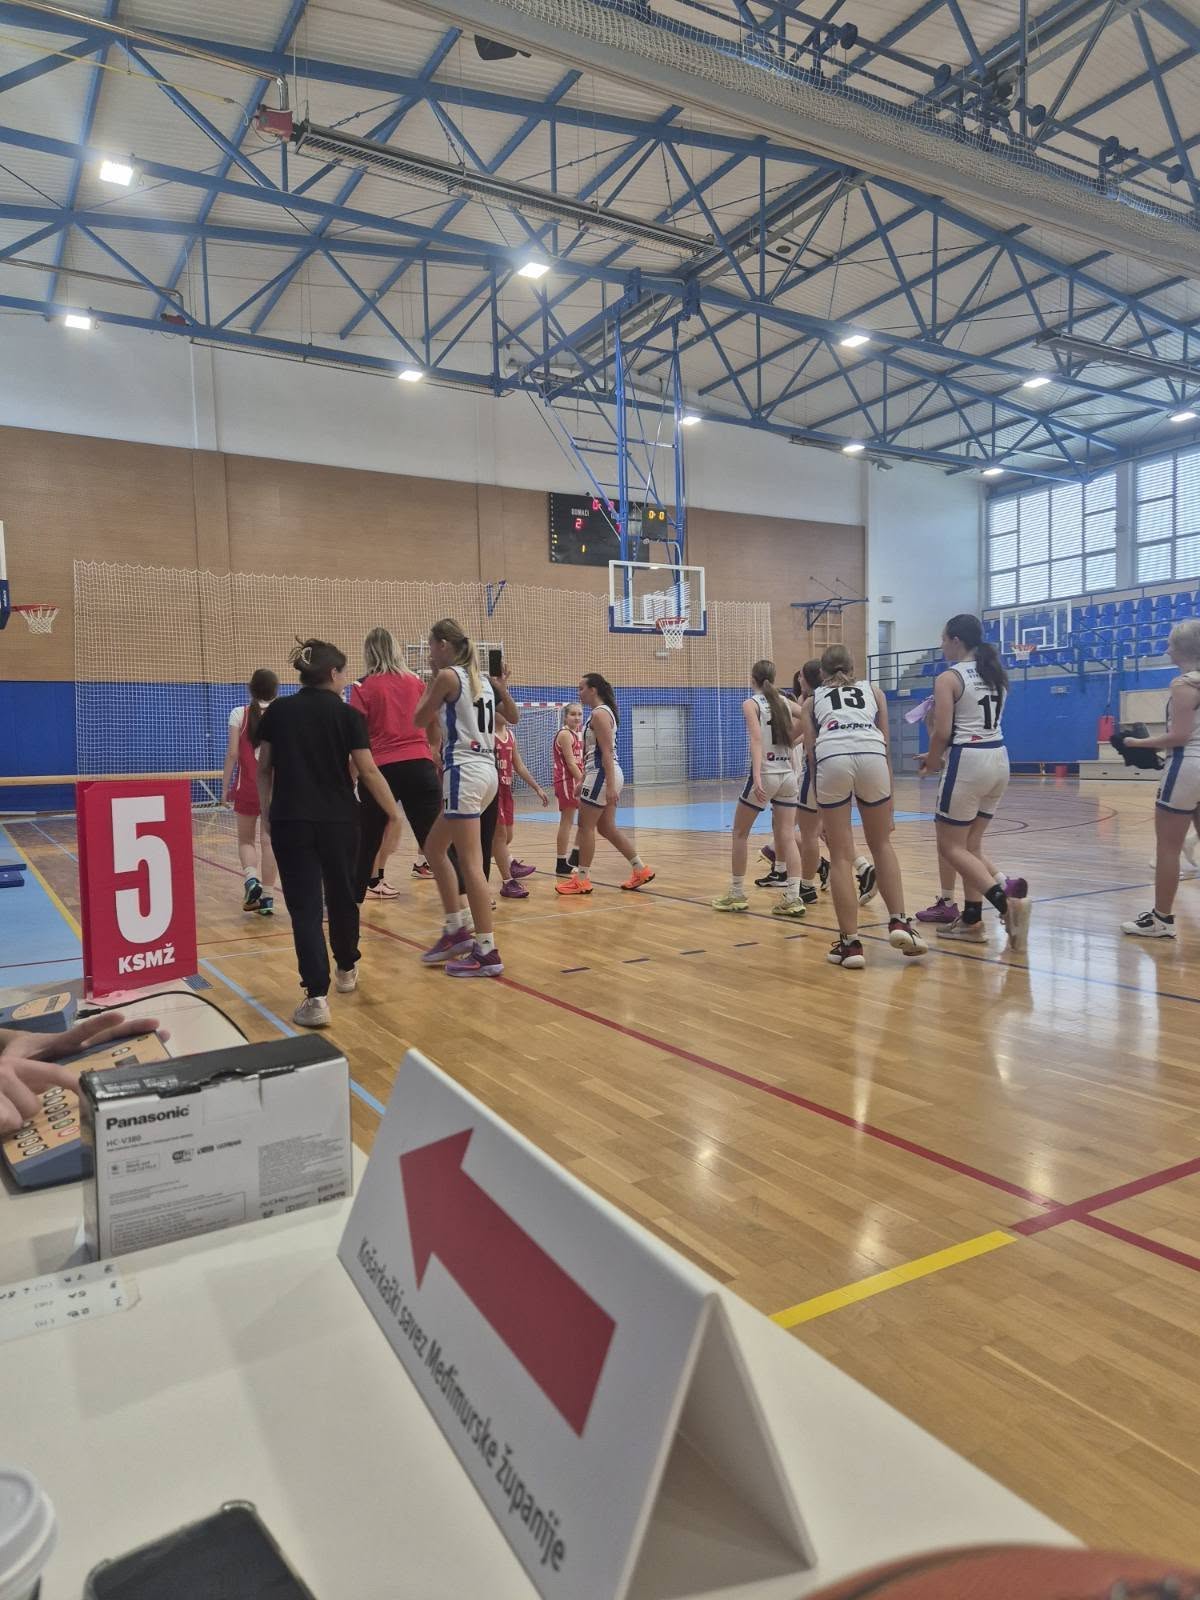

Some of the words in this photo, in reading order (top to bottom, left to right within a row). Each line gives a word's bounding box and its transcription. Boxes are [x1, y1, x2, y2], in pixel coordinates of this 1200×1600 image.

[575, 518, 582, 529] 2
[824, 687, 866, 710] 13
[977, 695, 1003, 729] 17
[473, 697, 494, 734] 11
[111, 795, 174, 944] 5
[118, 943, 176, 975] KSMŽ
[106, 1106, 190, 1130] Panasonic
[356, 1237, 406, 1318] Košarkaški
[398, 1305, 430, 1359] savez
[424, 1338, 500, 1470] Međimurske
[495, 1443, 567, 1574] županije
